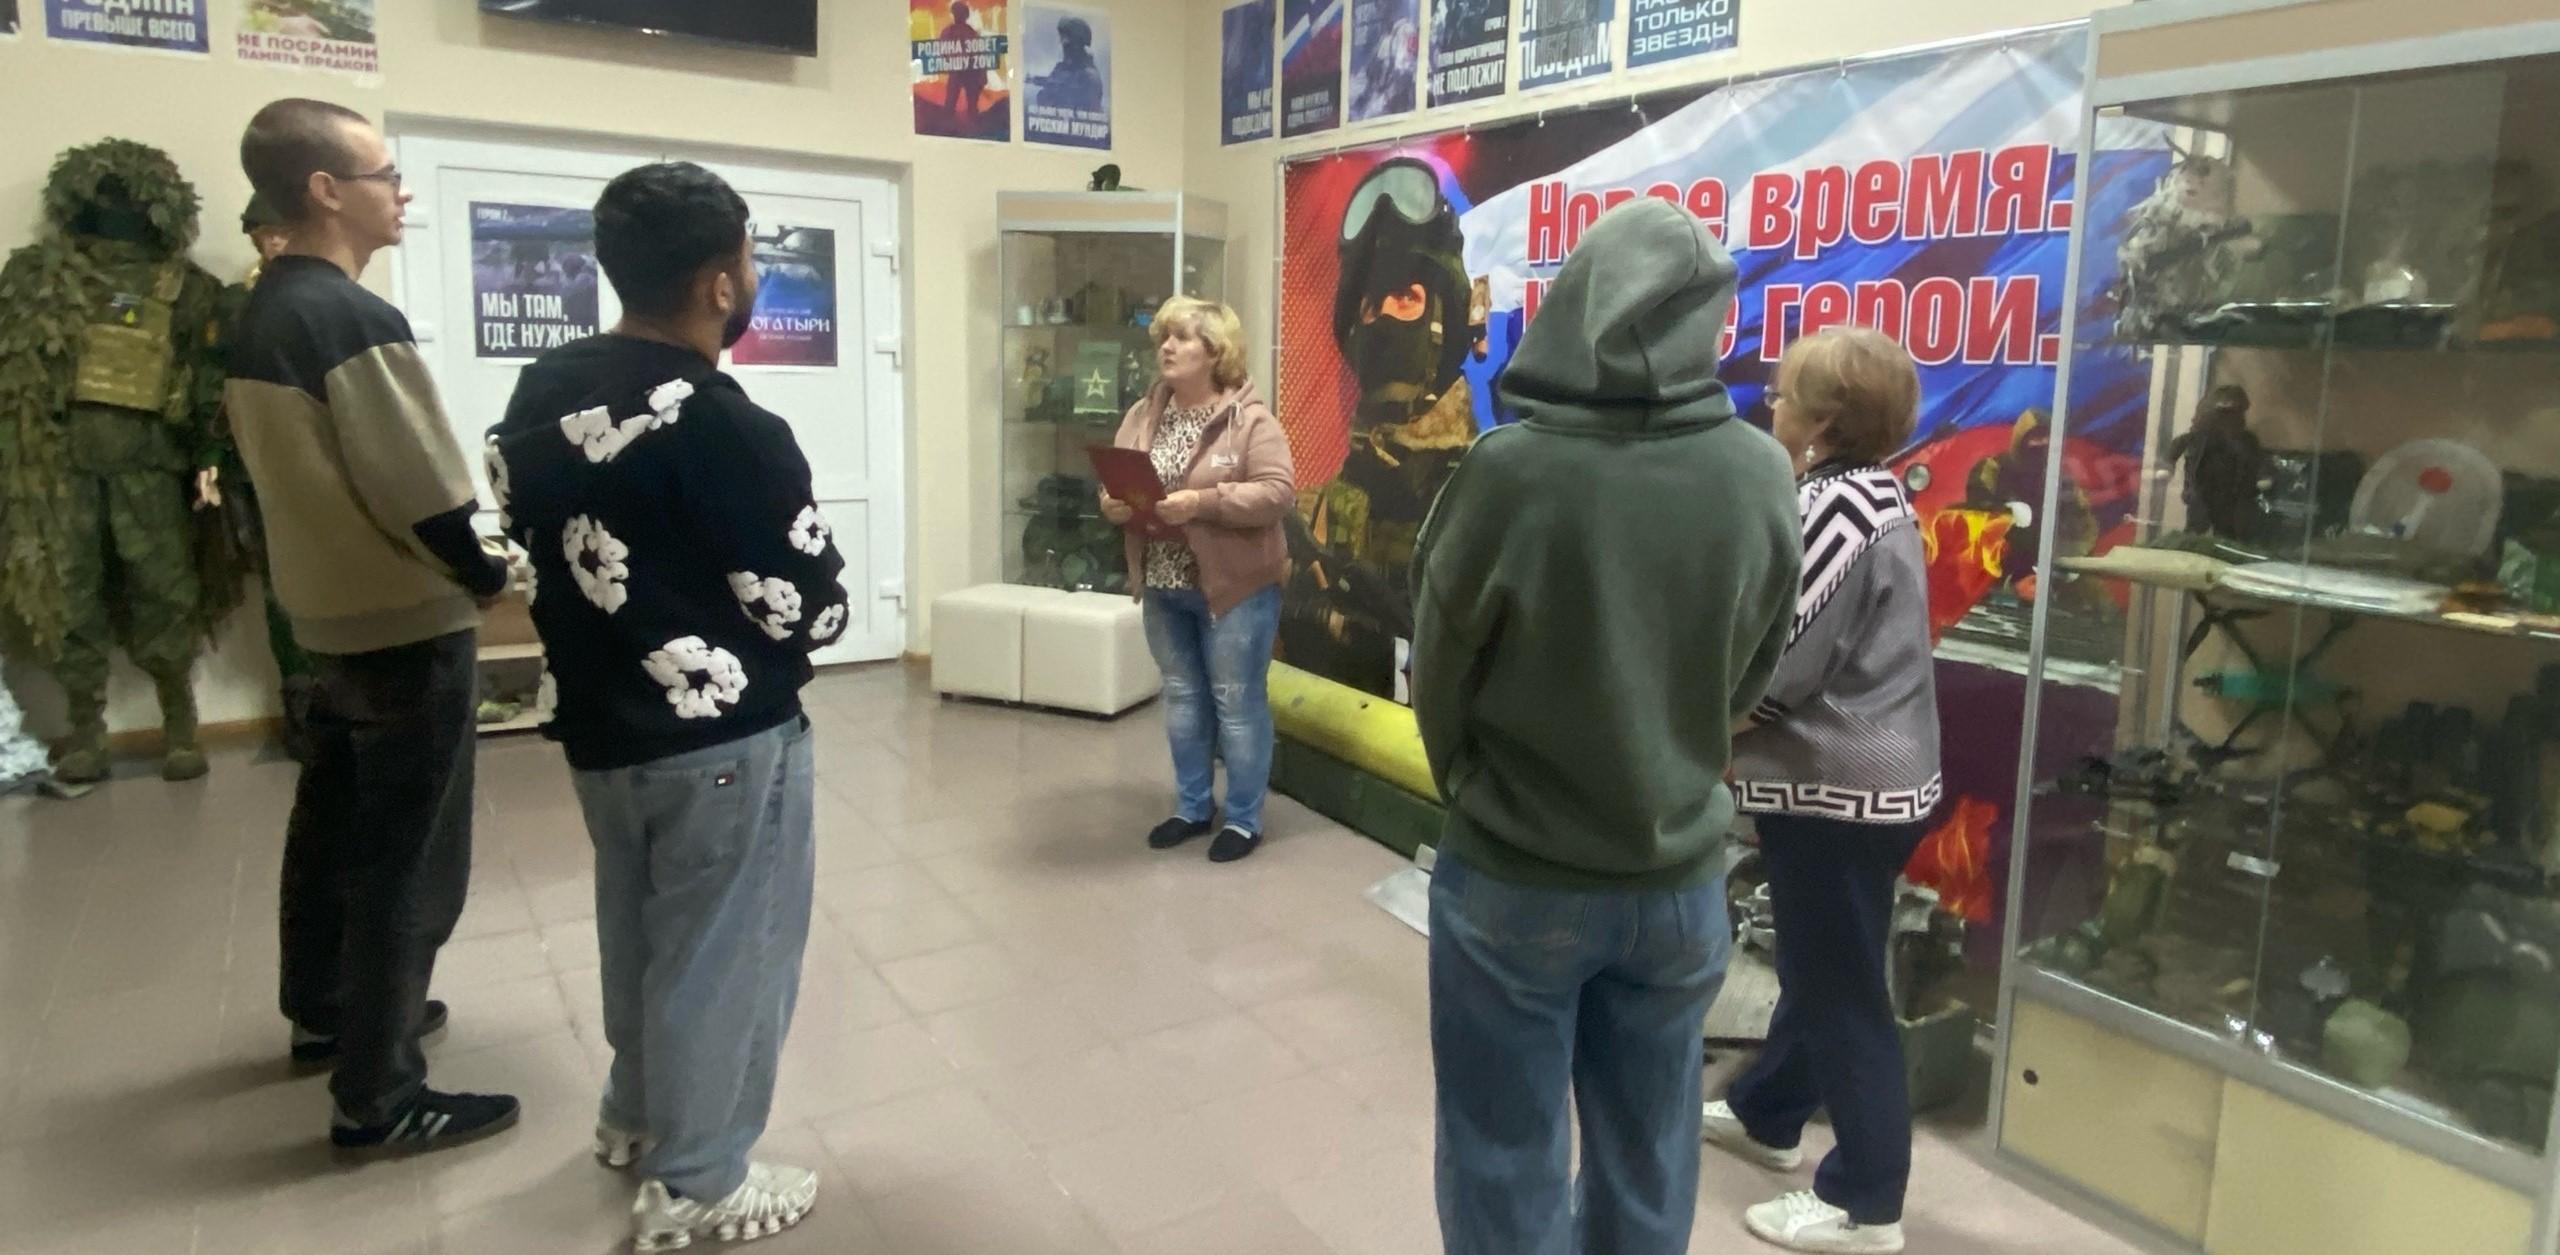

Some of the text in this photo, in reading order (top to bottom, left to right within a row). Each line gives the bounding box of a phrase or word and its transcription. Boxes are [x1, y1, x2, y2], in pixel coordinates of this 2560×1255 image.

[1634, 0, 1728, 33] ТОЛЬКО
[1635, 0, 1680, 12] НА
[61, 9, 196, 42] ПРЕВЫШЕ ВСЕГО
[1632, 18, 1734, 56] ЗВЕЗДЫ
[237, 33, 378, 59] НЕ ПОСРАМИМ
[918, 41, 962, 57] РОДИНА
[238, 48, 378, 72] ПАМЯТЬ ПРЕДКОВ!
[927, 54, 996, 72] СЛЫШУ ZOV!
[1433, 60, 1505, 96] НЕ ПОДЛЕЖИТ
[1029, 117, 1108, 140] РУССКИЙ МУНДИР
[1527, 144, 2074, 264] Ное время.
[482, 292, 568, 322] МЫ ТАМ,
[483, 322, 516, 350] ГДЕ
[748, 316, 831, 333] ОГАТЫРИ
